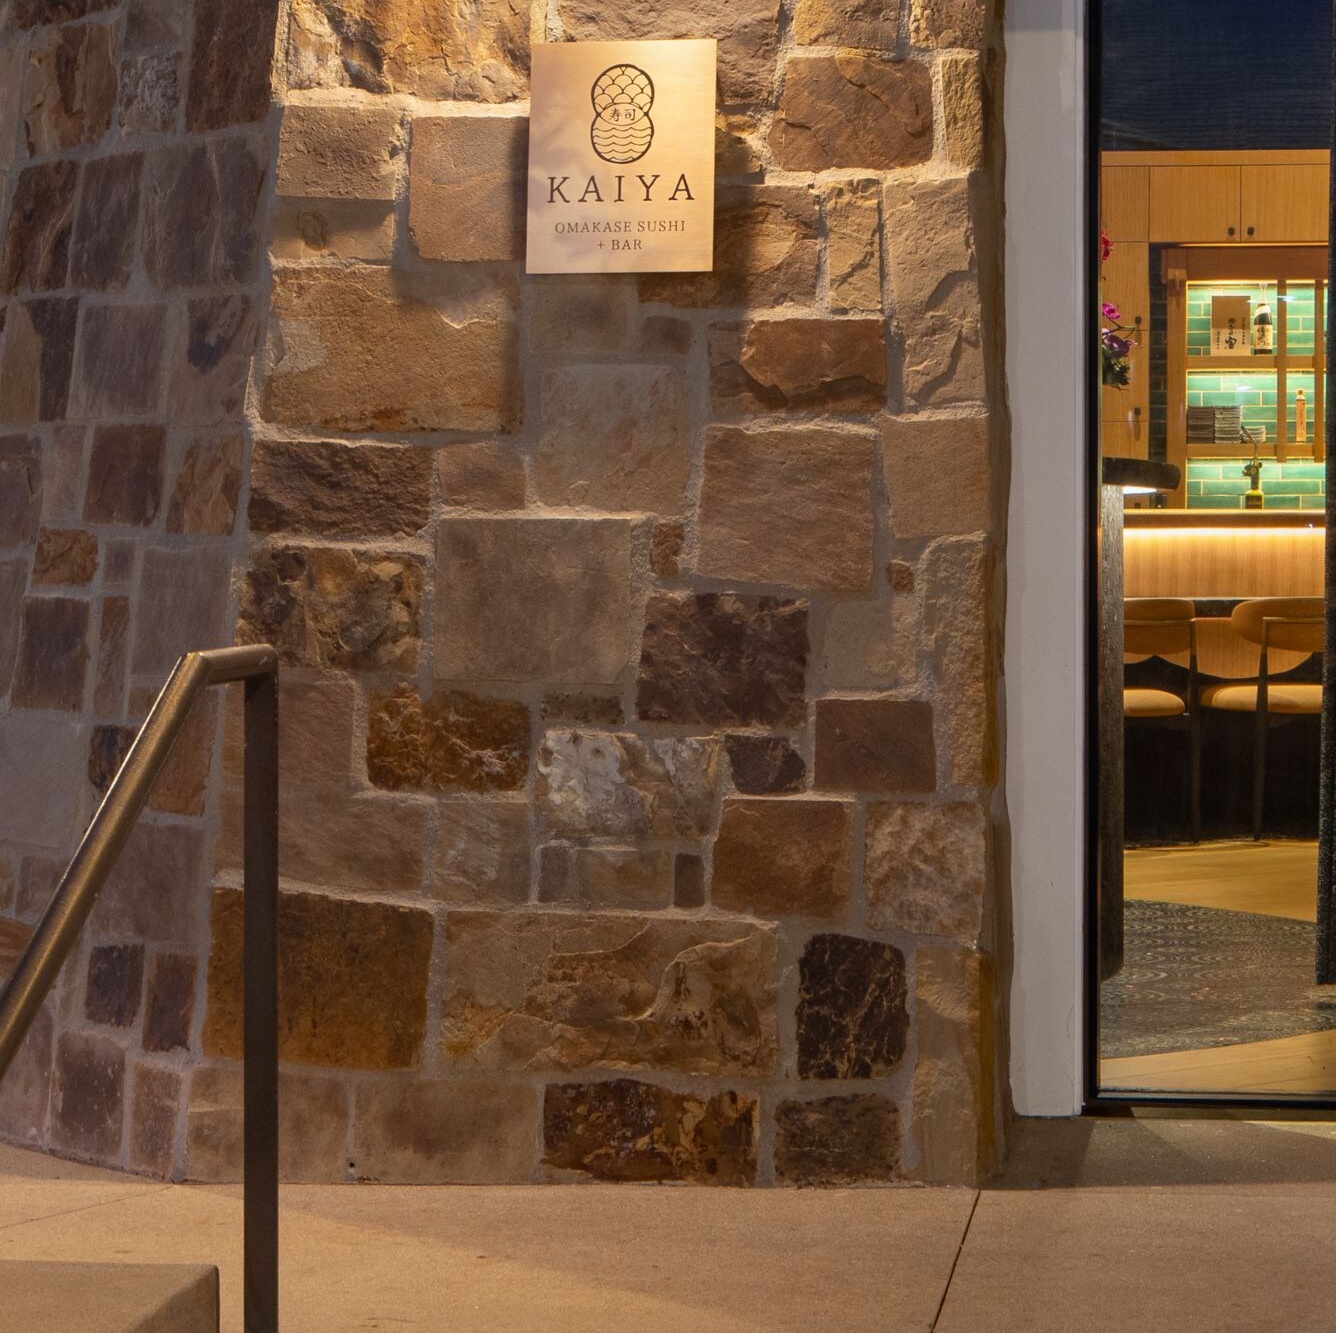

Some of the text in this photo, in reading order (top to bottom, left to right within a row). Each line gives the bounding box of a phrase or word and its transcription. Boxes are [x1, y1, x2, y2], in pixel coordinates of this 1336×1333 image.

[609, 107, 636, 122] 寿司
[547, 173, 696, 204] KAIYA
[554, 220, 686, 234] OMAKASE SUSHI
[597, 239, 643, 251] + BAR
